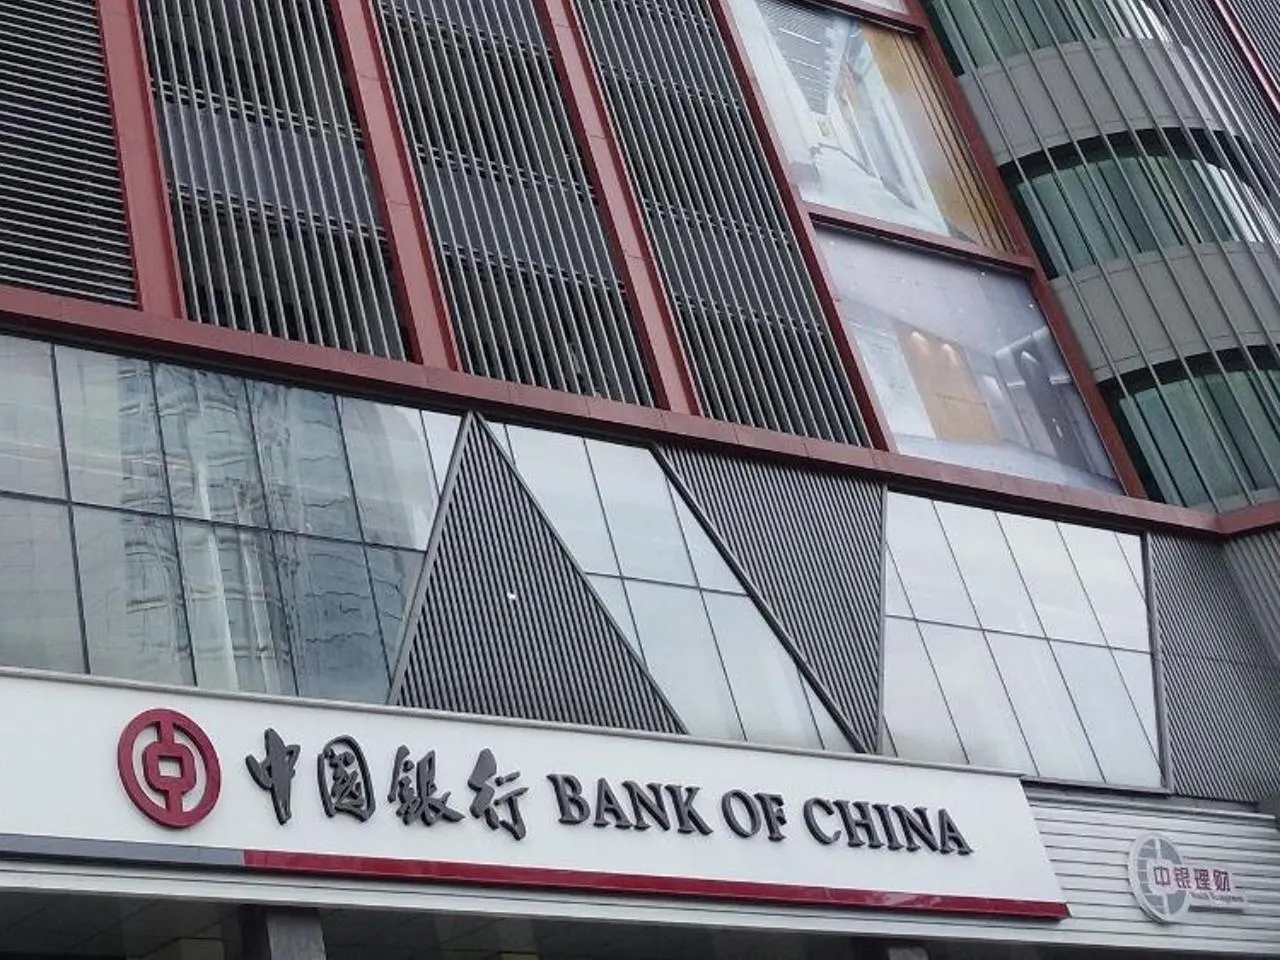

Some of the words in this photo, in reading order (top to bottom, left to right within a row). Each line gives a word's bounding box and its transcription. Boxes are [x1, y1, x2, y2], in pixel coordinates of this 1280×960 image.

[546, 773, 714, 835] BANK
[721, 789, 787, 841] OF
[803, 796, 973, 855] CHINA
[1153, 865, 1231, 892] 中银理财
